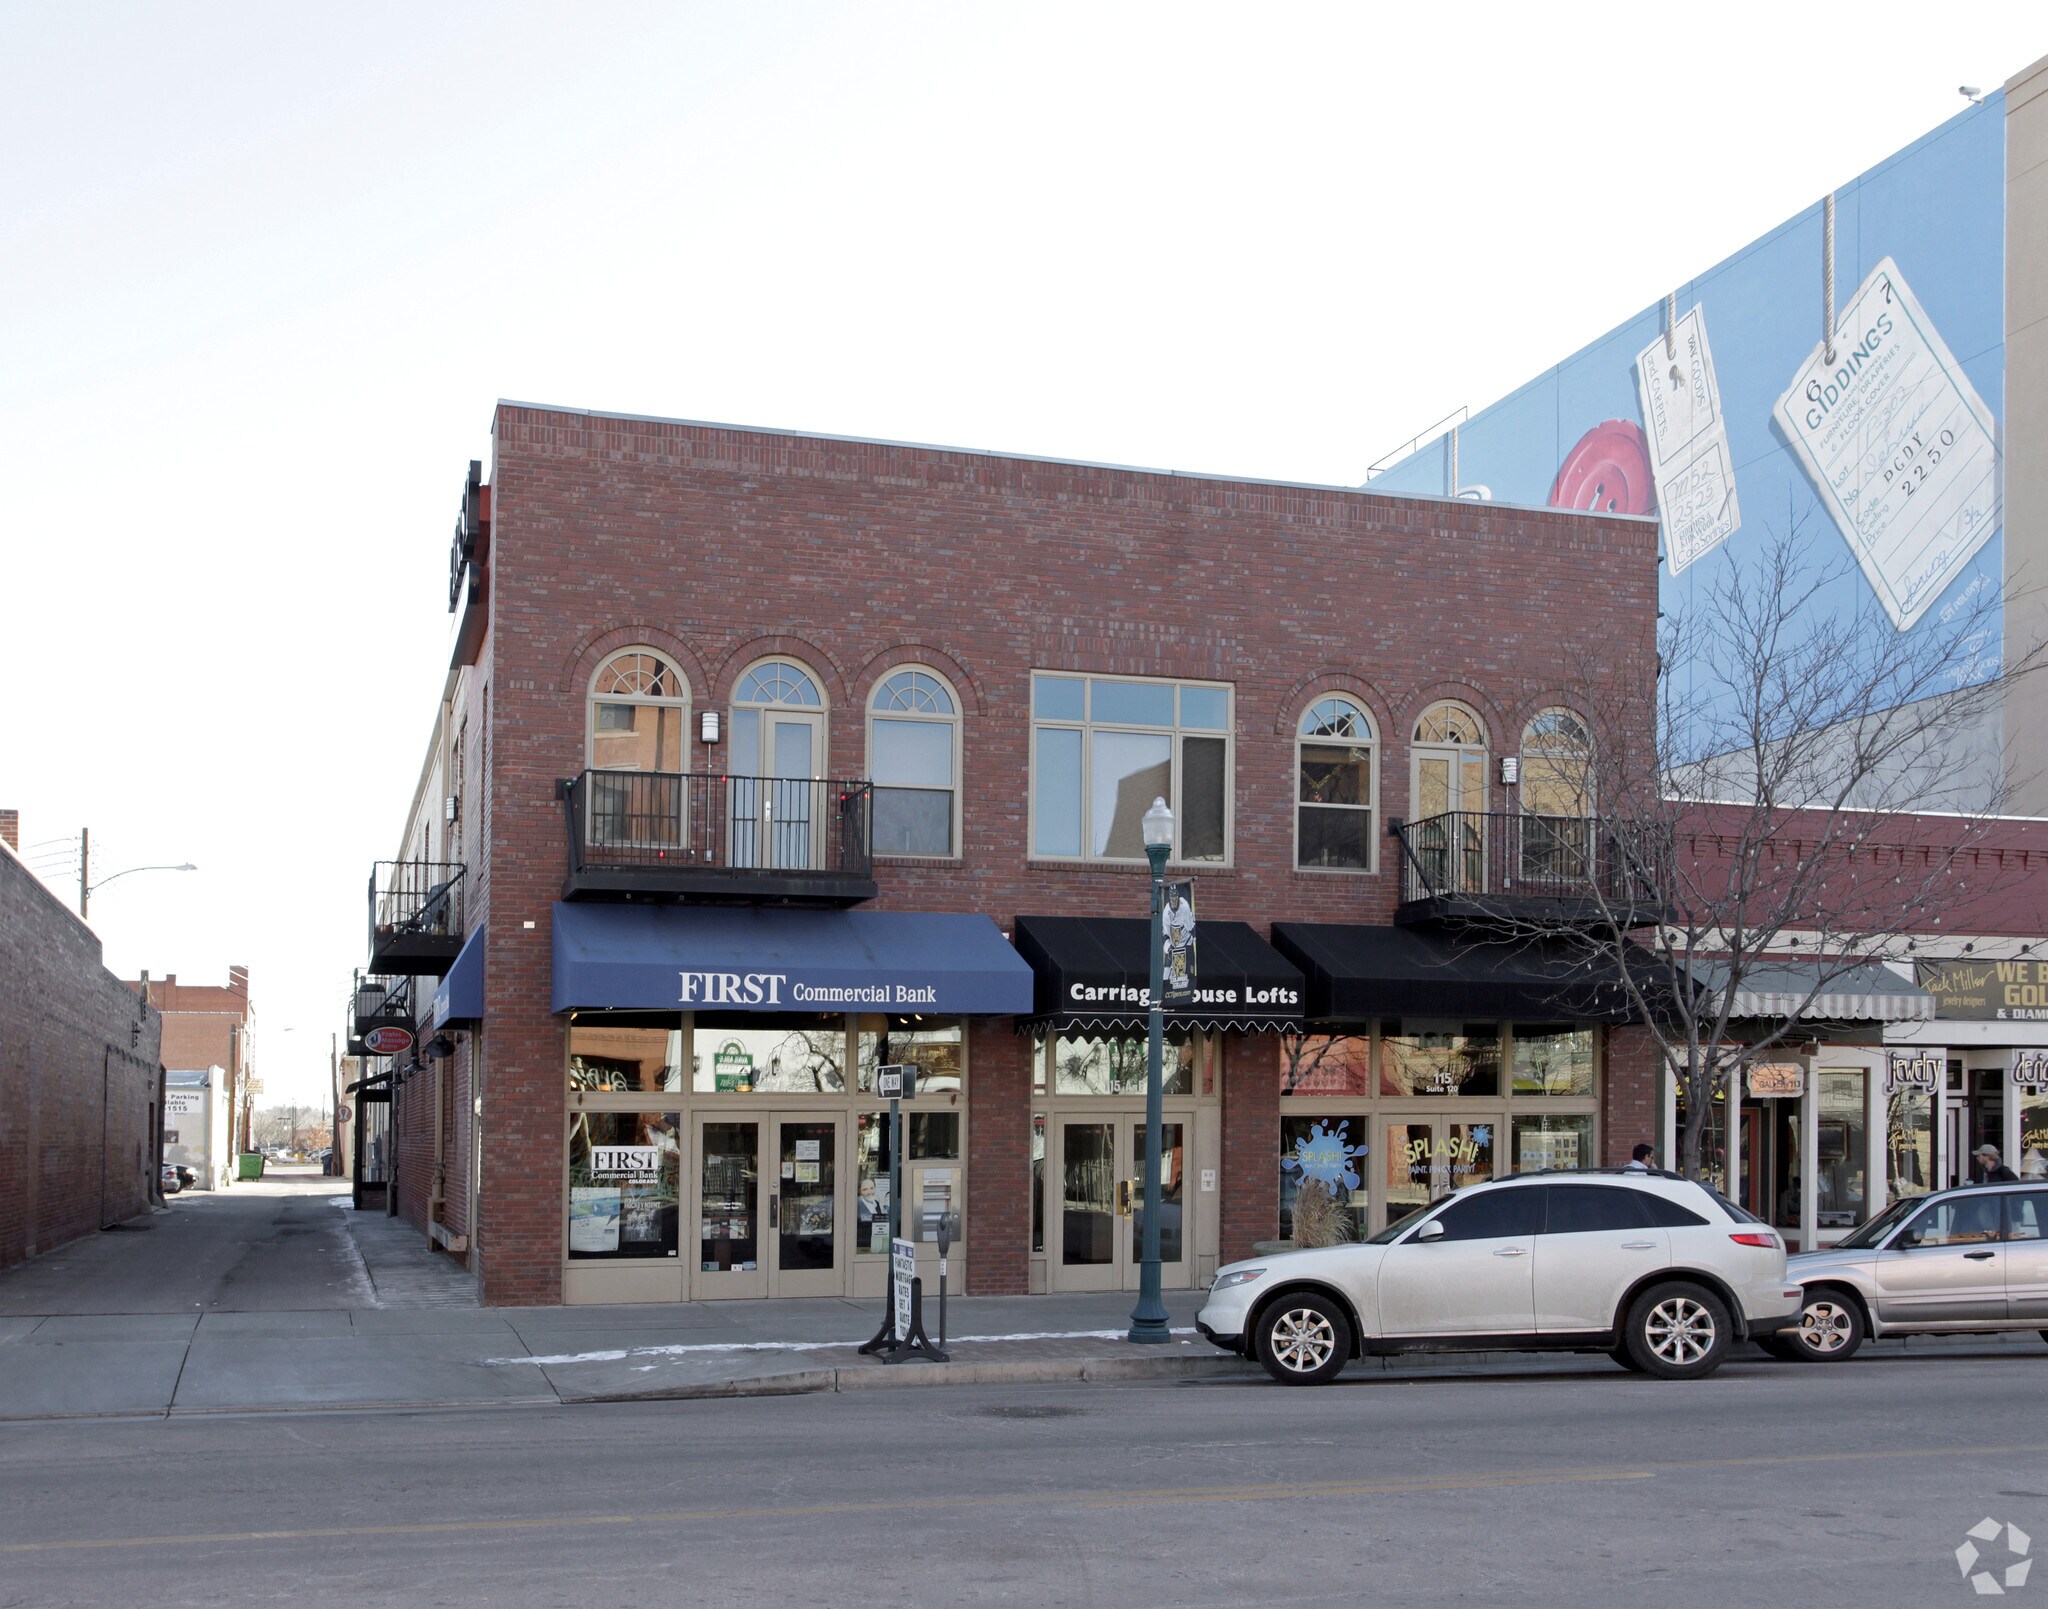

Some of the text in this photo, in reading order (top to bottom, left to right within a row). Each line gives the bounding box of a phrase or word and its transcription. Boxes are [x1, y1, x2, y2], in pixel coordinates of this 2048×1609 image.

[1806, 313, 1893, 430] GIDDINGS
[1819, 398, 1858, 449] FURNITURE
[1860, 343, 1901, 394] DRAPERIES
[1840, 407, 1866, 440] FLOOR
[1865, 372, 1891, 405] COVER
[1902, 429, 1954, 497] 2250
[1832, 465, 1850, 489] Lot
[1921, 967, 1994, 995] Jack Miller
[1996, 962, 2028, 982] WE
[679, 972, 937, 1004] FIRST Commercial Bank
[1070, 983, 1298, 1007] Carriag ouse Lofts
[1943, 996, 1962, 1007] jewelry
[1996, 1008, 2007, 1018] &
[1433, 1073, 1452, 1084] 115
[1889, 1051, 1941, 1091] jewelry
[883, 1075, 900, 1089] ONE WAY
[1446, 1085, 1458, 1093] 120
[594, 1151, 658, 1169] FIRST
[1302, 1150, 1342, 1162] SPLASH!
[1403, 1137, 1479, 1164] SPLASH!
[592, 1171, 658, 1179] Commercial Bank
[894, 1256, 913, 1272] FANTASTIC
[898, 1285, 910, 1298] RATES
[899, 1311, 910, 1325] QUOTE
